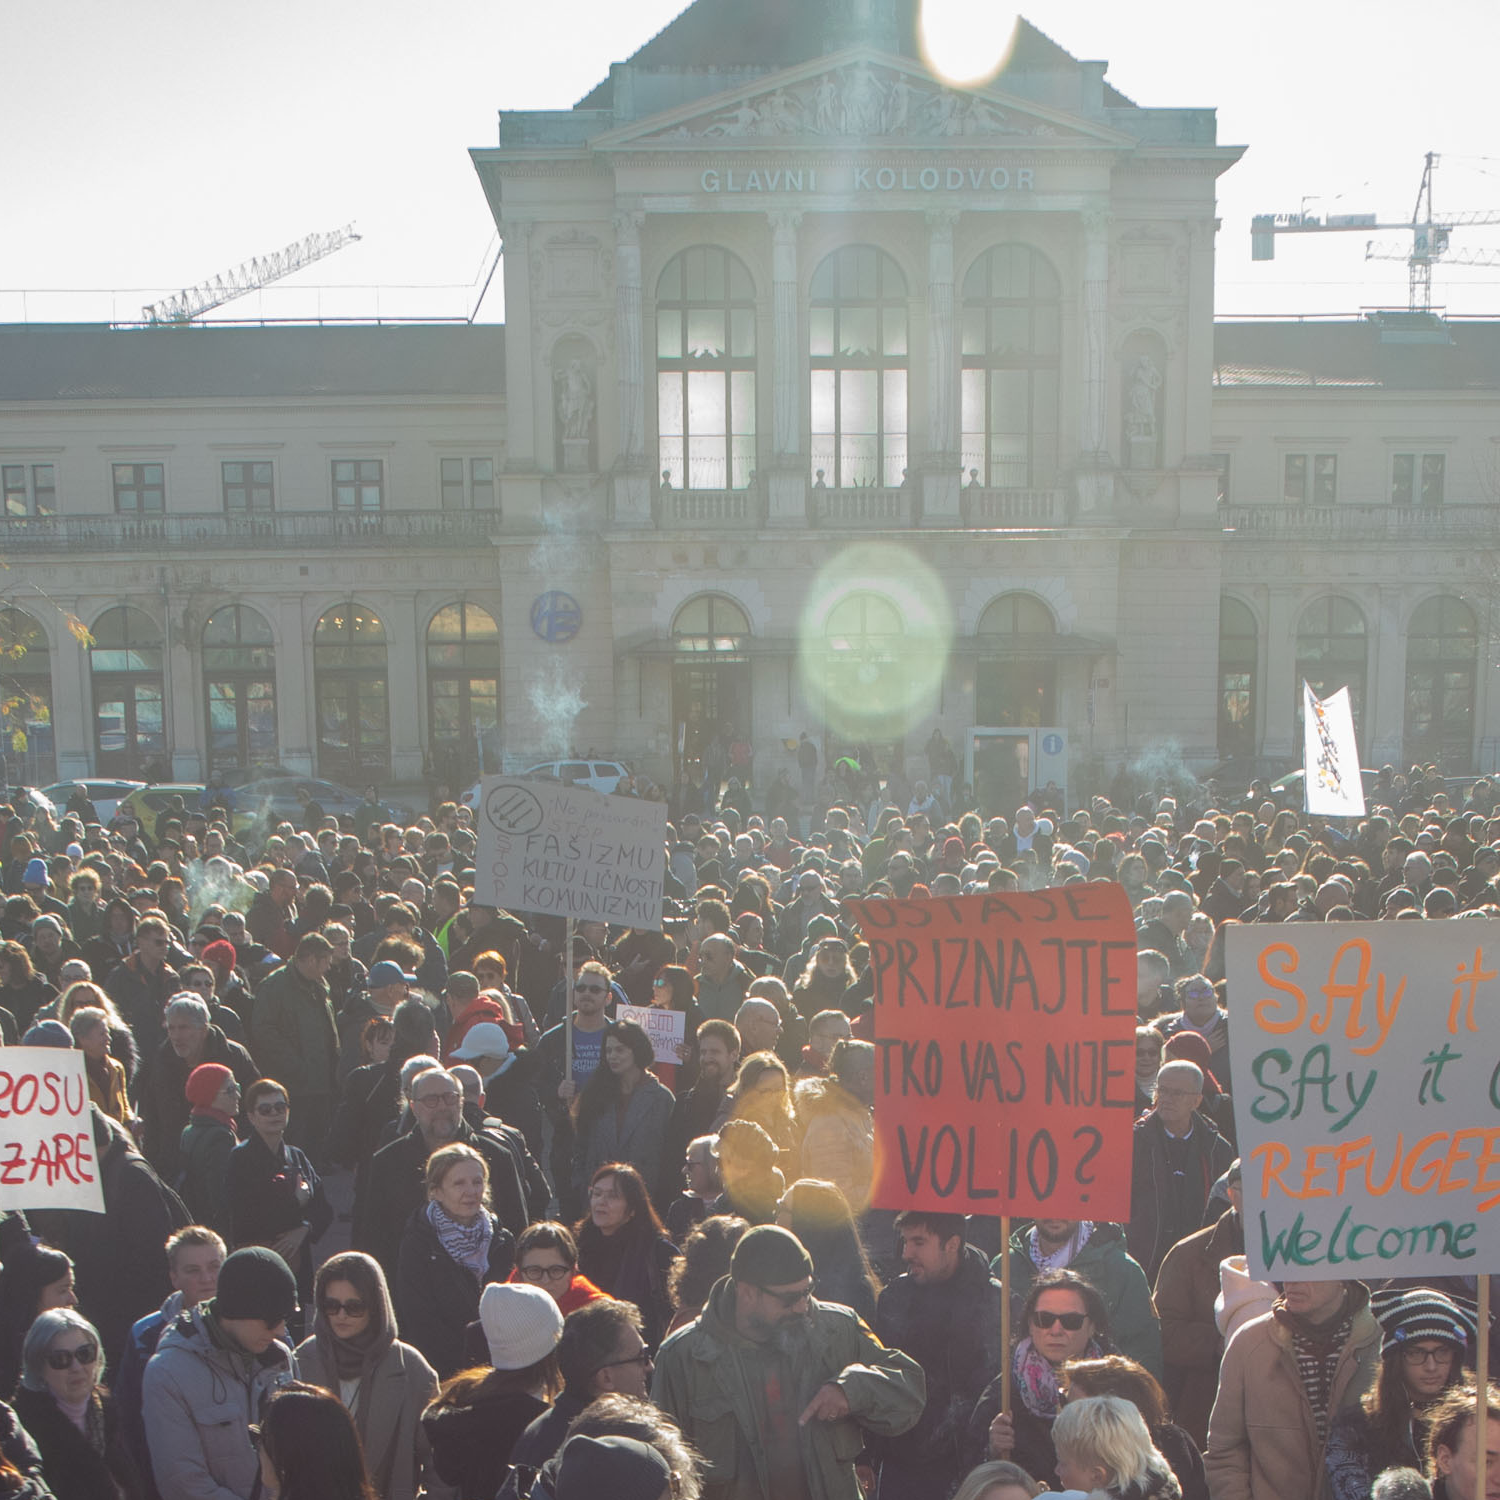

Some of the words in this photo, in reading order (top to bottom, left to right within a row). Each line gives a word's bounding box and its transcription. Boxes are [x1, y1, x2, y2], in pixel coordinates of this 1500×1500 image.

[701, 169, 818, 192] GLAVNI
[853, 167, 1035, 191] KOLODVOR
[523, 857, 576, 882] KULTU
[583, 869, 662, 898] LIČNOSTI
[526, 834, 654, 871] FAŠIZMU
[523, 884, 655, 921] KOMUNIZMU
[870, 937, 1136, 1016] PRIZNAJTE
[1447, 947, 1498, 1035] it
[875, 1038, 943, 1097] TKO
[960, 1040, 1027, 1104] VAS
[1045, 1040, 1135, 1108] NIJE
[1419, 1042, 1462, 1103] it
[897, 1124, 1104, 1203] VOLIO?
